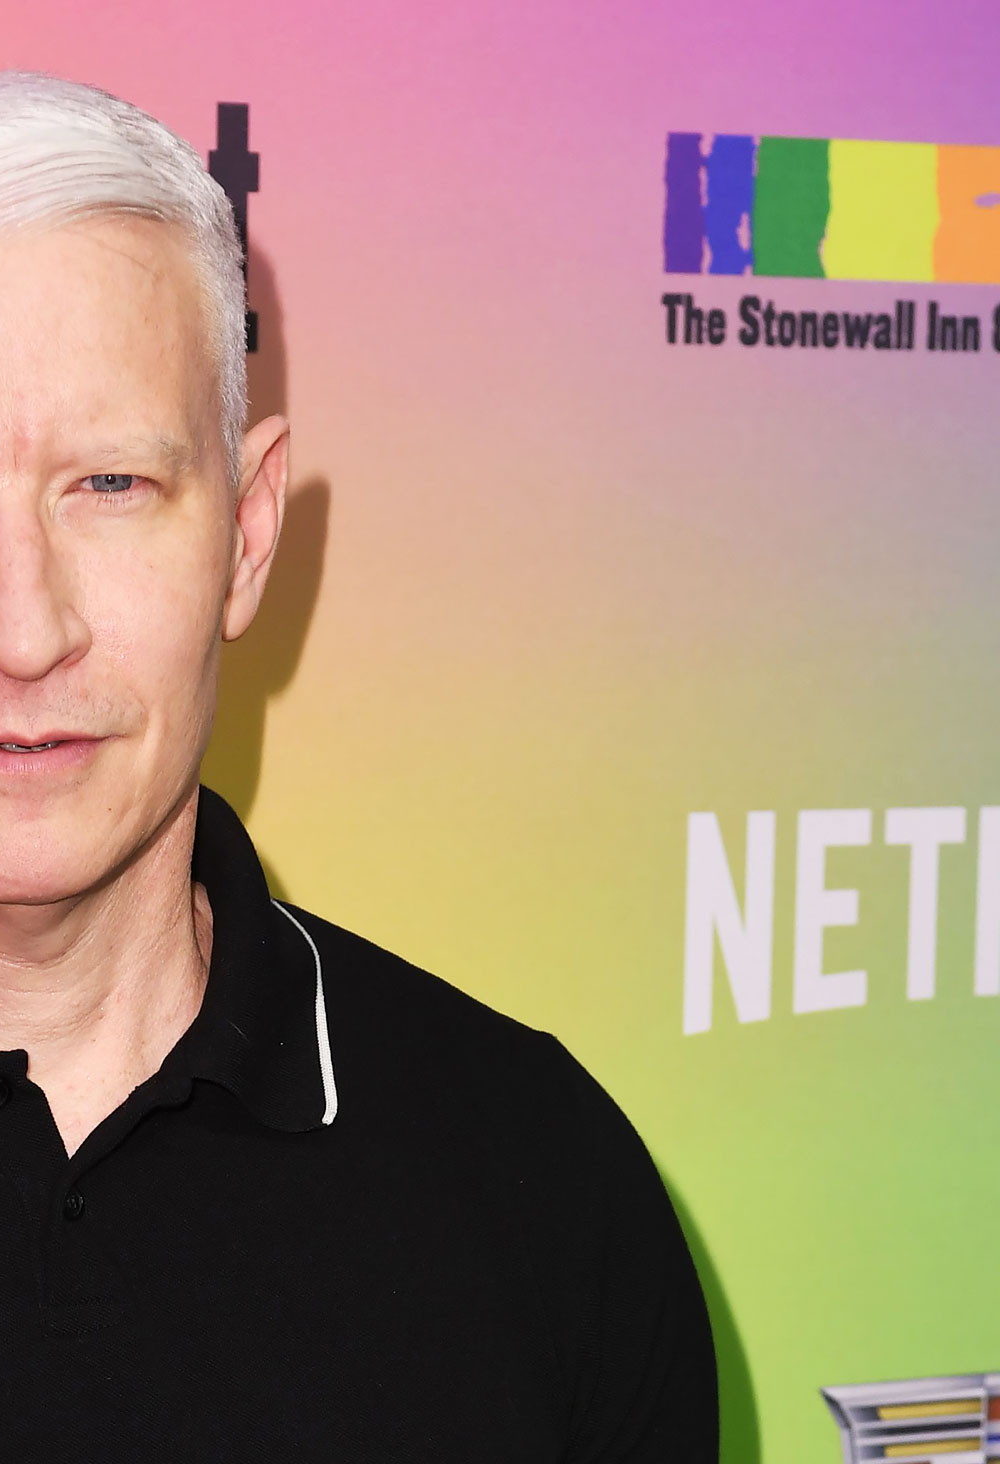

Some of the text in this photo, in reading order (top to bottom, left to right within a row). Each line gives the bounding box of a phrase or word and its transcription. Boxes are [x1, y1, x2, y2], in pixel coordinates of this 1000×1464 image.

[661, 292, 726, 345] The
[739, 295, 915, 351] Stonewall
[928, 300, 980, 352] Inn
